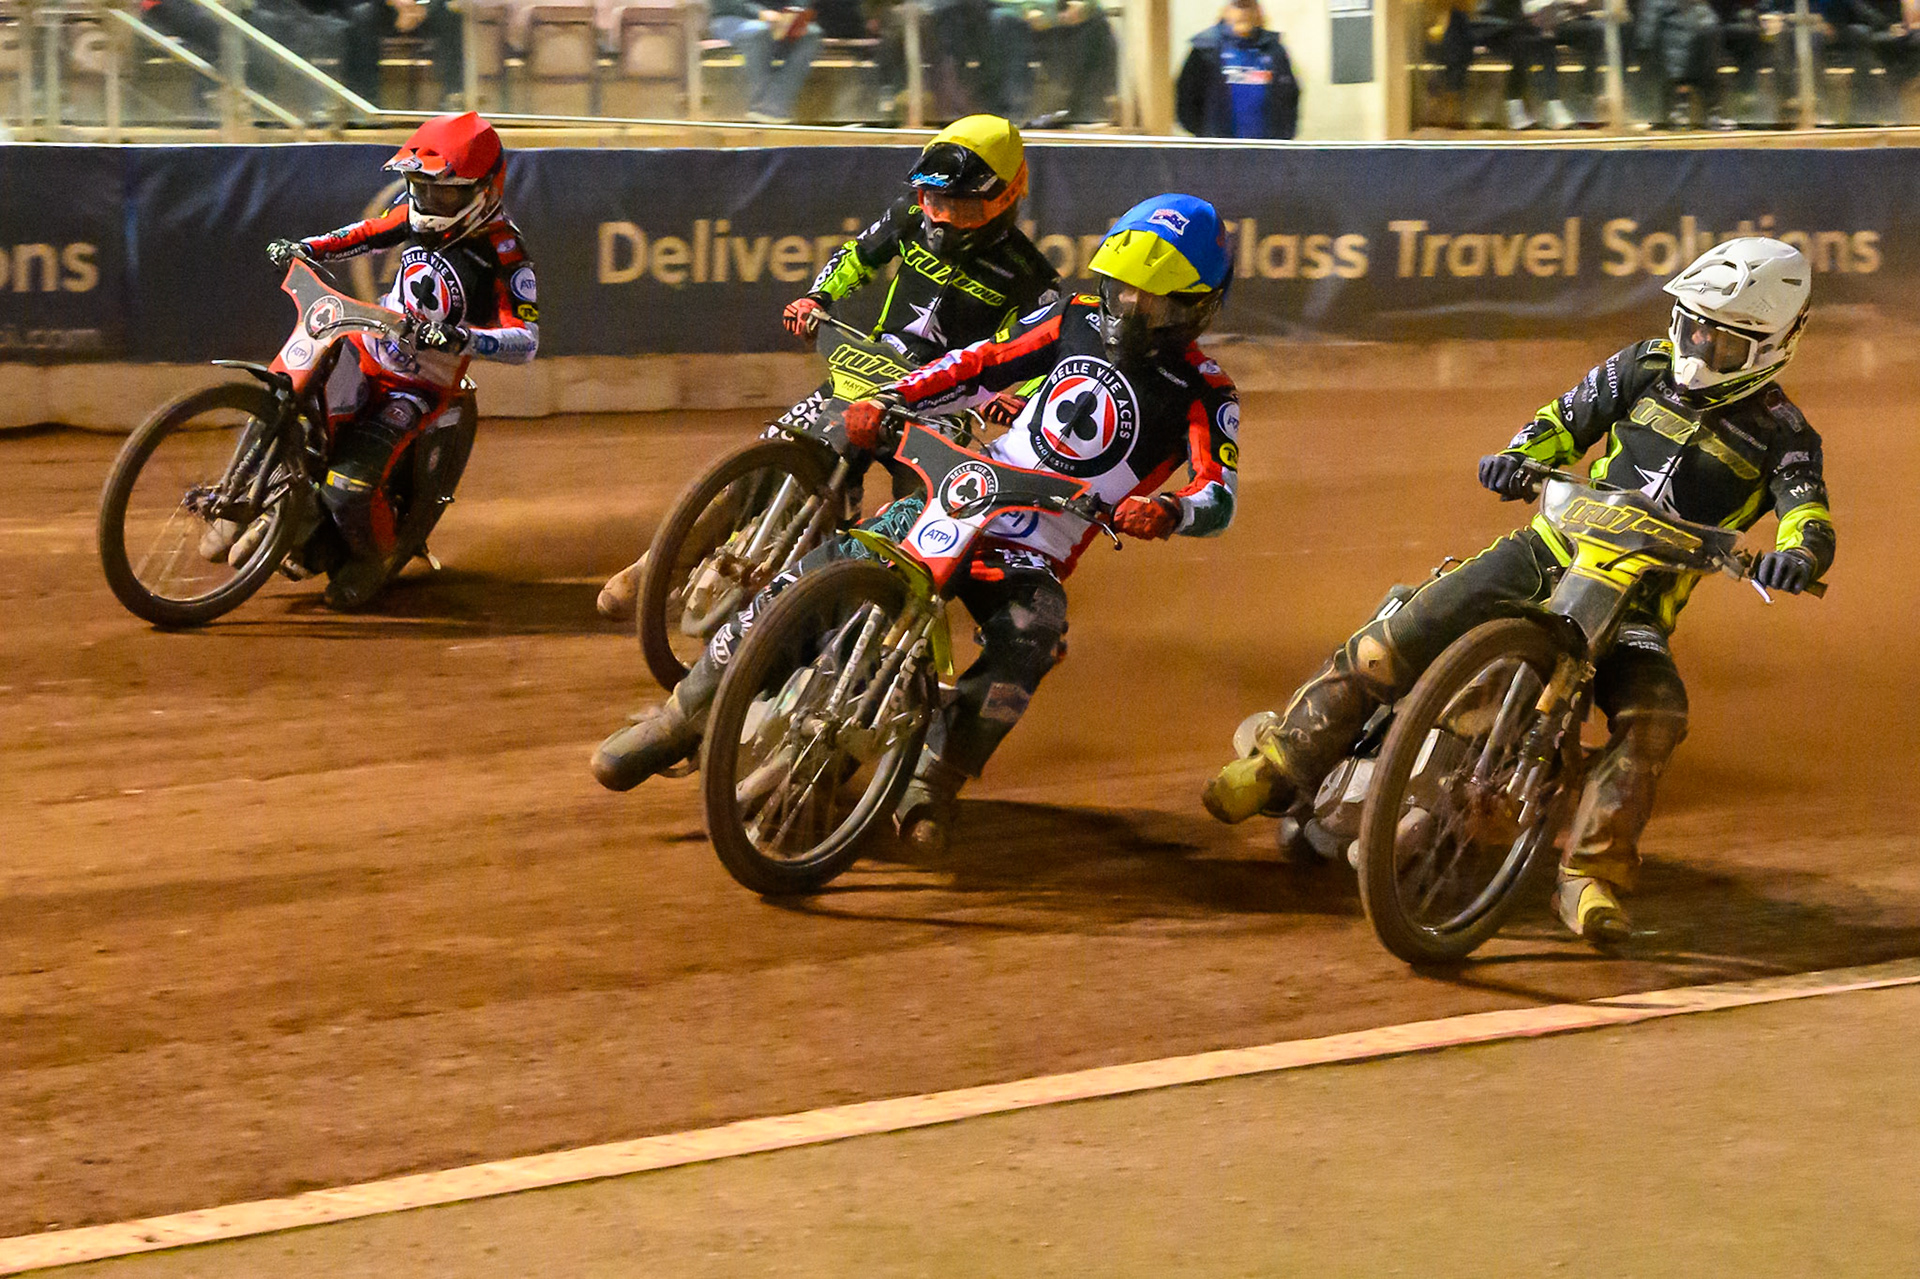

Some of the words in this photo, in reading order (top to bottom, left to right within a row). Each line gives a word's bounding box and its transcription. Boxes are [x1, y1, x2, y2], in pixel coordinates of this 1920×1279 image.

[0, 242, 99, 292] ns
[1222, 217, 1368, 279] lass
[1388, 216, 1581, 278] Travel
[291, 346, 308, 360] ATPI
[1050, 362, 1091, 385] BELLE
[1096, 367, 1122, 395] VUE
[1117, 398, 1133, 440] ACES
[949, 464, 972, 481] BELLE
[974, 465, 988, 477] VUE
[985, 473, 996, 494] ACES
[924, 528, 952, 546] ATPI
